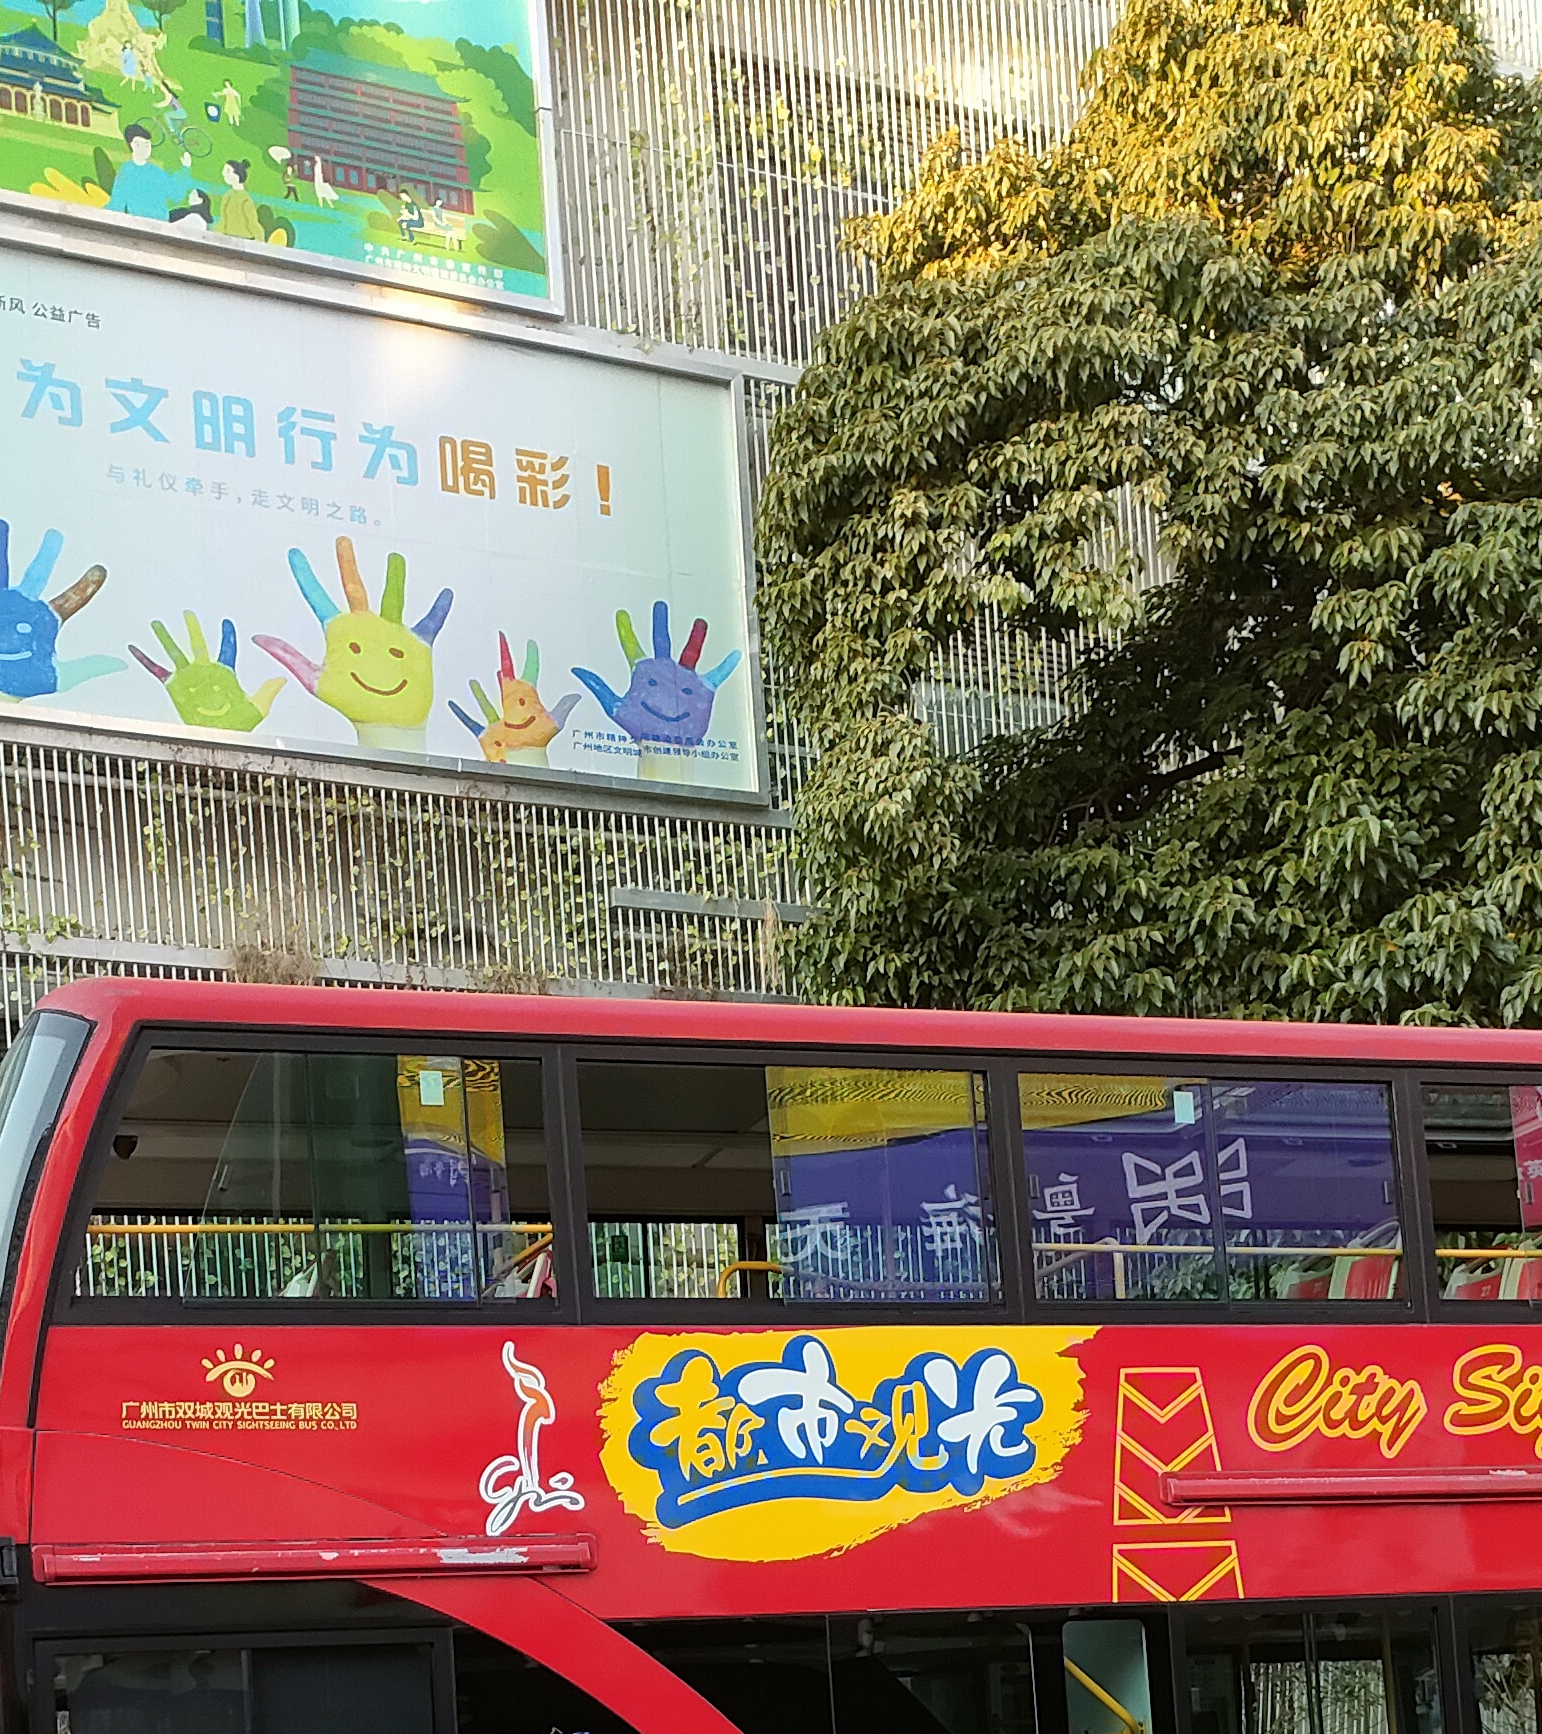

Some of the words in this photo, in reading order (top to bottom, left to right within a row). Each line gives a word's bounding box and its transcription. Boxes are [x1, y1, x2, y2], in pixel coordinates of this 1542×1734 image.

[32, 302, 101, 329] 公益广告
[17, 358, 612, 517] 为文明行为喝彩!
[121, 1401, 358, 1420] 广州市双城观光巴士有限公司
[122, 1420, 182, 1430] GUANGZHOU
[186, 1421, 210, 1430] TWIN
[213, 1421, 234, 1430] CITY
[237, 1420, 296, 1430] SIGHTSEEING
[299, 1420, 318, 1430] BUS
[645, 1338, 1039, 1484] 都市观光
[1246, 1343, 1429, 1460] City
